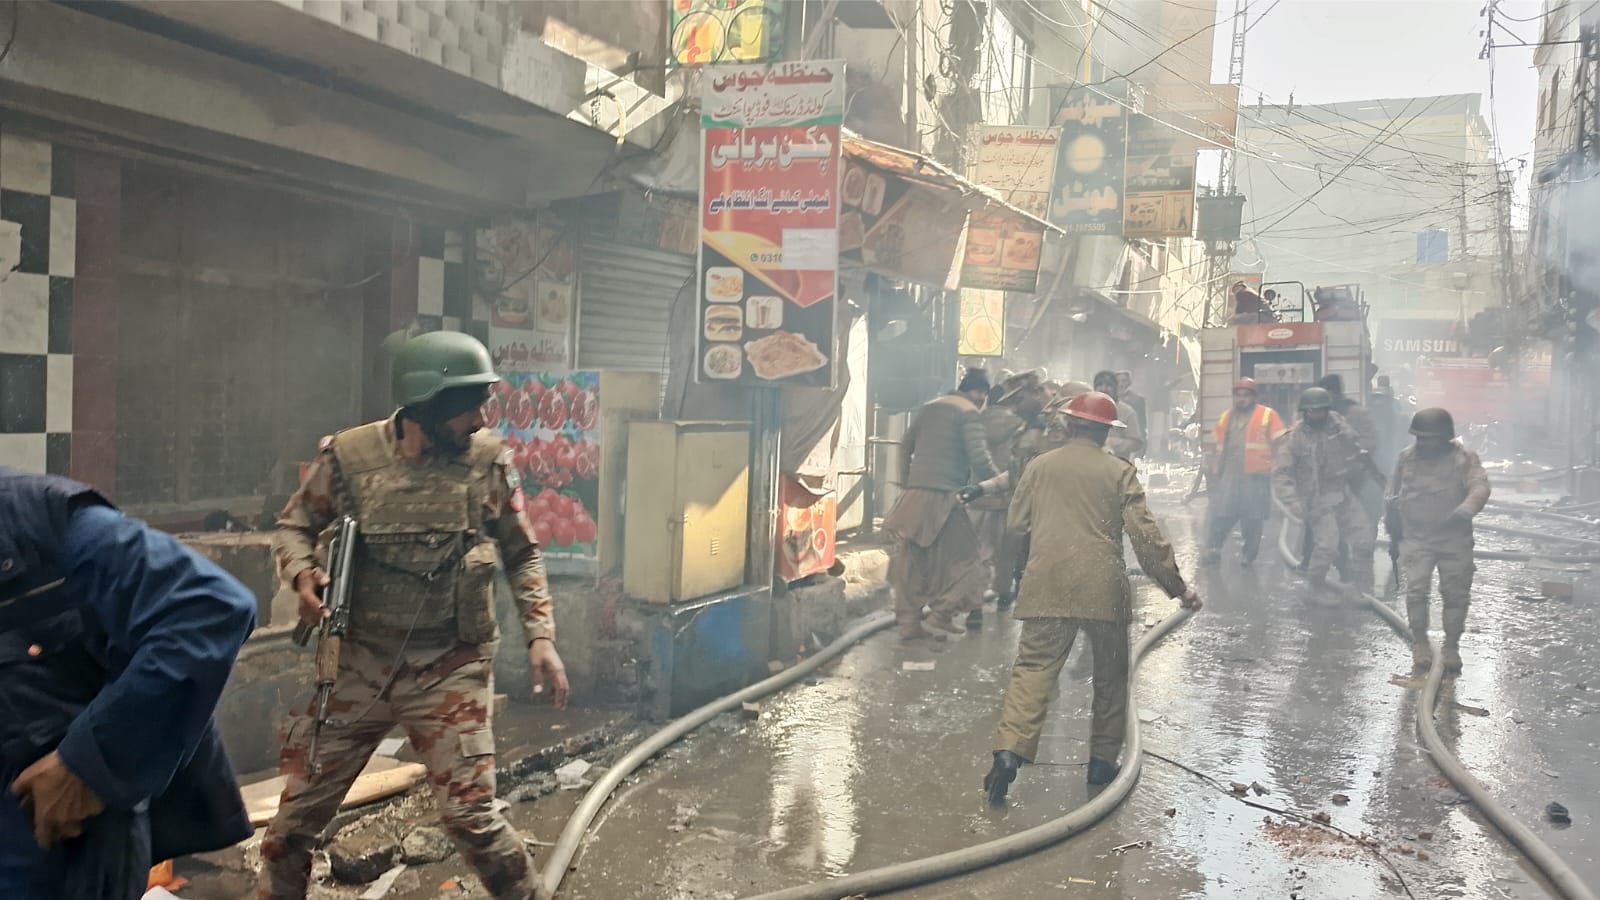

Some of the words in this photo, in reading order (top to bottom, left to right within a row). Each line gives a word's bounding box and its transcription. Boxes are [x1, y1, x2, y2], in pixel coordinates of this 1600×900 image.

[713, 69, 765, 92] جوس
[711, 128, 777, 168] بریانی
[779, 125, 832, 172] چکن
[1384, 338, 1458, 353] SAMSUN
